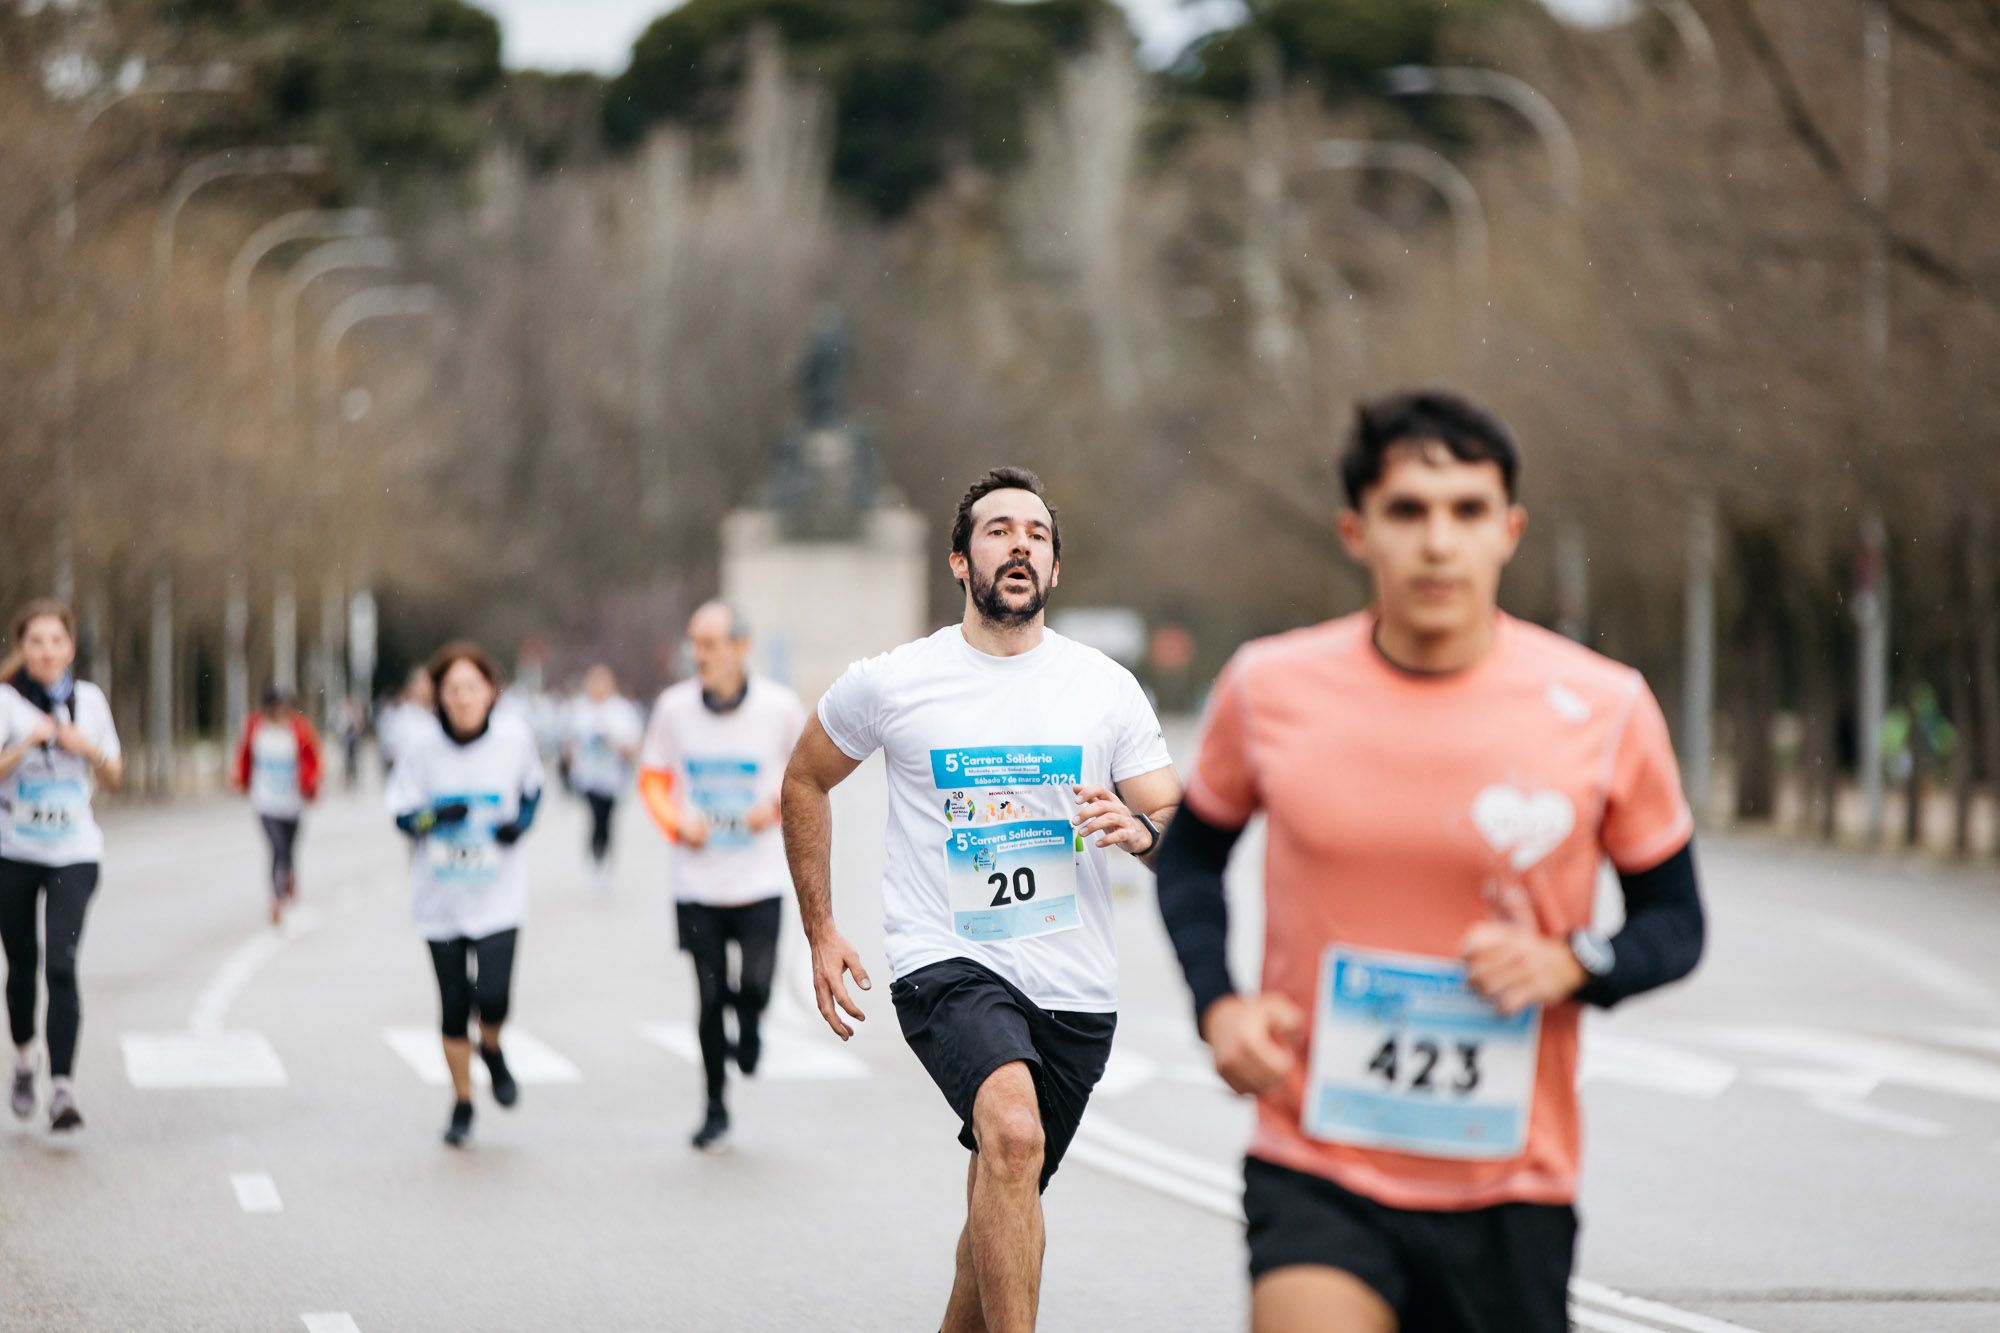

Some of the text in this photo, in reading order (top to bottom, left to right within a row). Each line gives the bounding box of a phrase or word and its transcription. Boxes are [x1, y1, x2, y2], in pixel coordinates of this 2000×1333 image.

[962, 755, 1003, 766] Carrera
[1006, 752, 1052, 764] Solidaria
[975, 776, 1000, 785] Sábado
[1002, 776, 1006, 784] 7
[1041, 773, 1077, 785] 2026
[970, 834, 1006, 846] Carrera
[1008, 828, 1052, 839] Solidaria
[988, 867, 1035, 907] 20
[1368, 1034, 1481, 1096] 423
